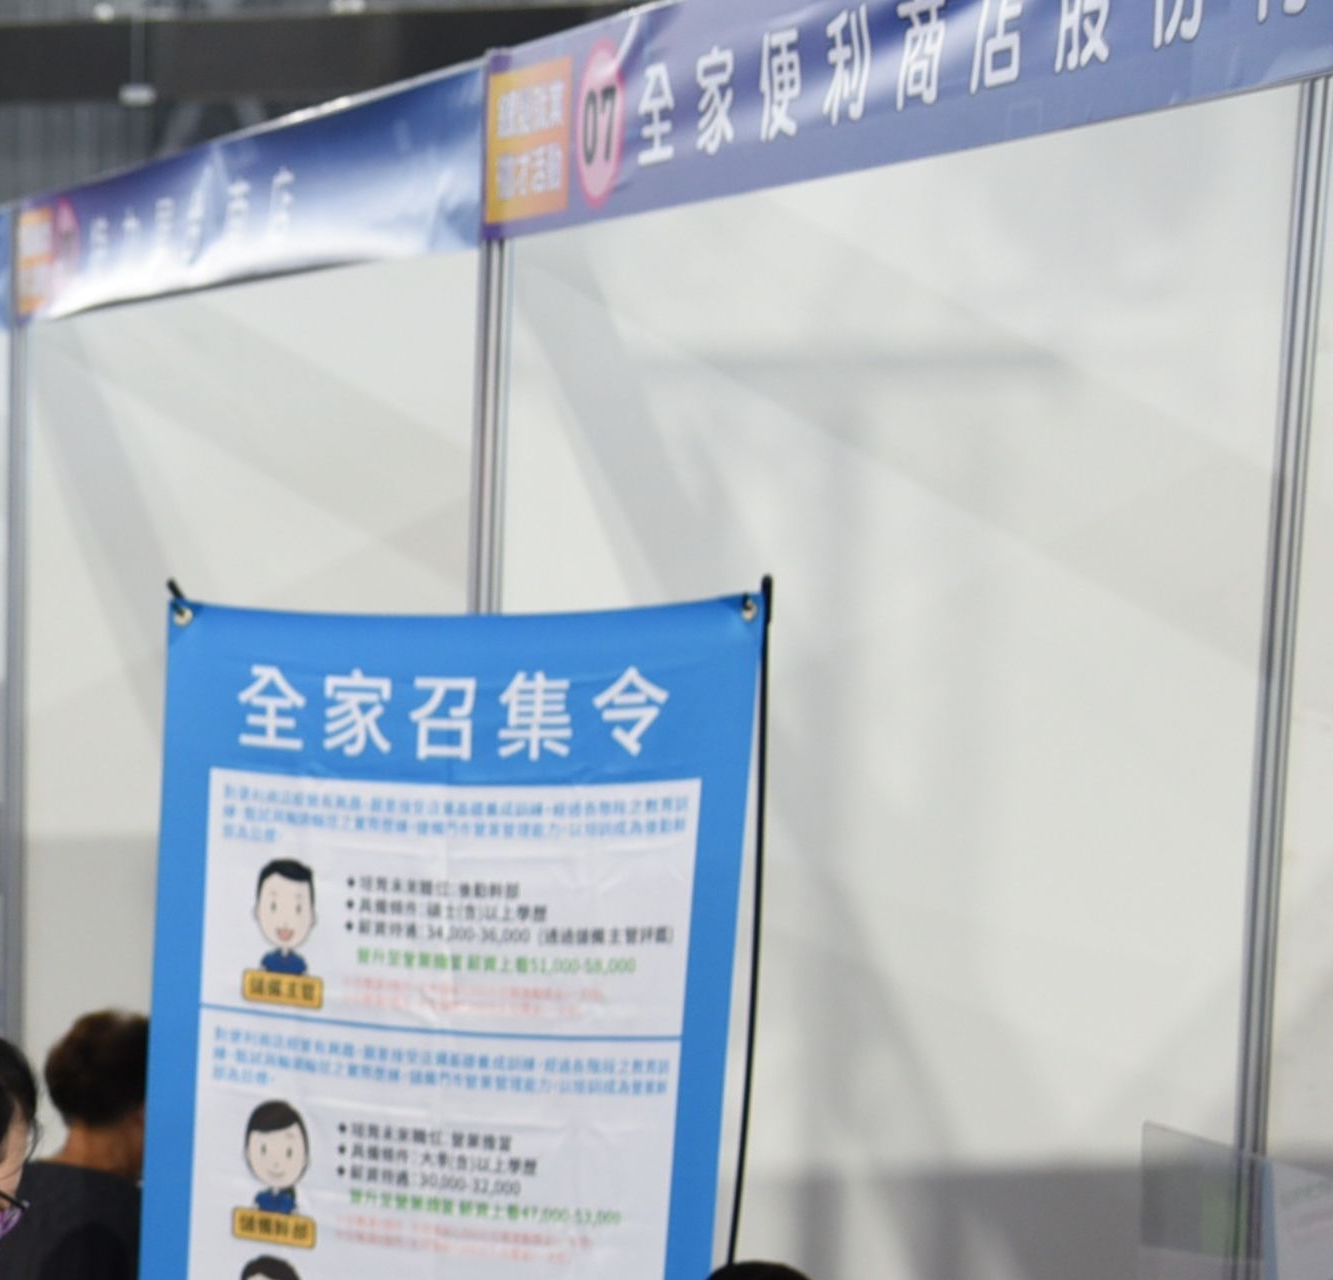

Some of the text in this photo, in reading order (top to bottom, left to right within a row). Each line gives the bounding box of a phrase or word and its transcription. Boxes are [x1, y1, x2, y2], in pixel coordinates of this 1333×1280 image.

[583, 85, 616, 166] 07
[637, 0, 1307, 168] 全家便利商店股
[237, 664, 670, 762] 全家召集令
